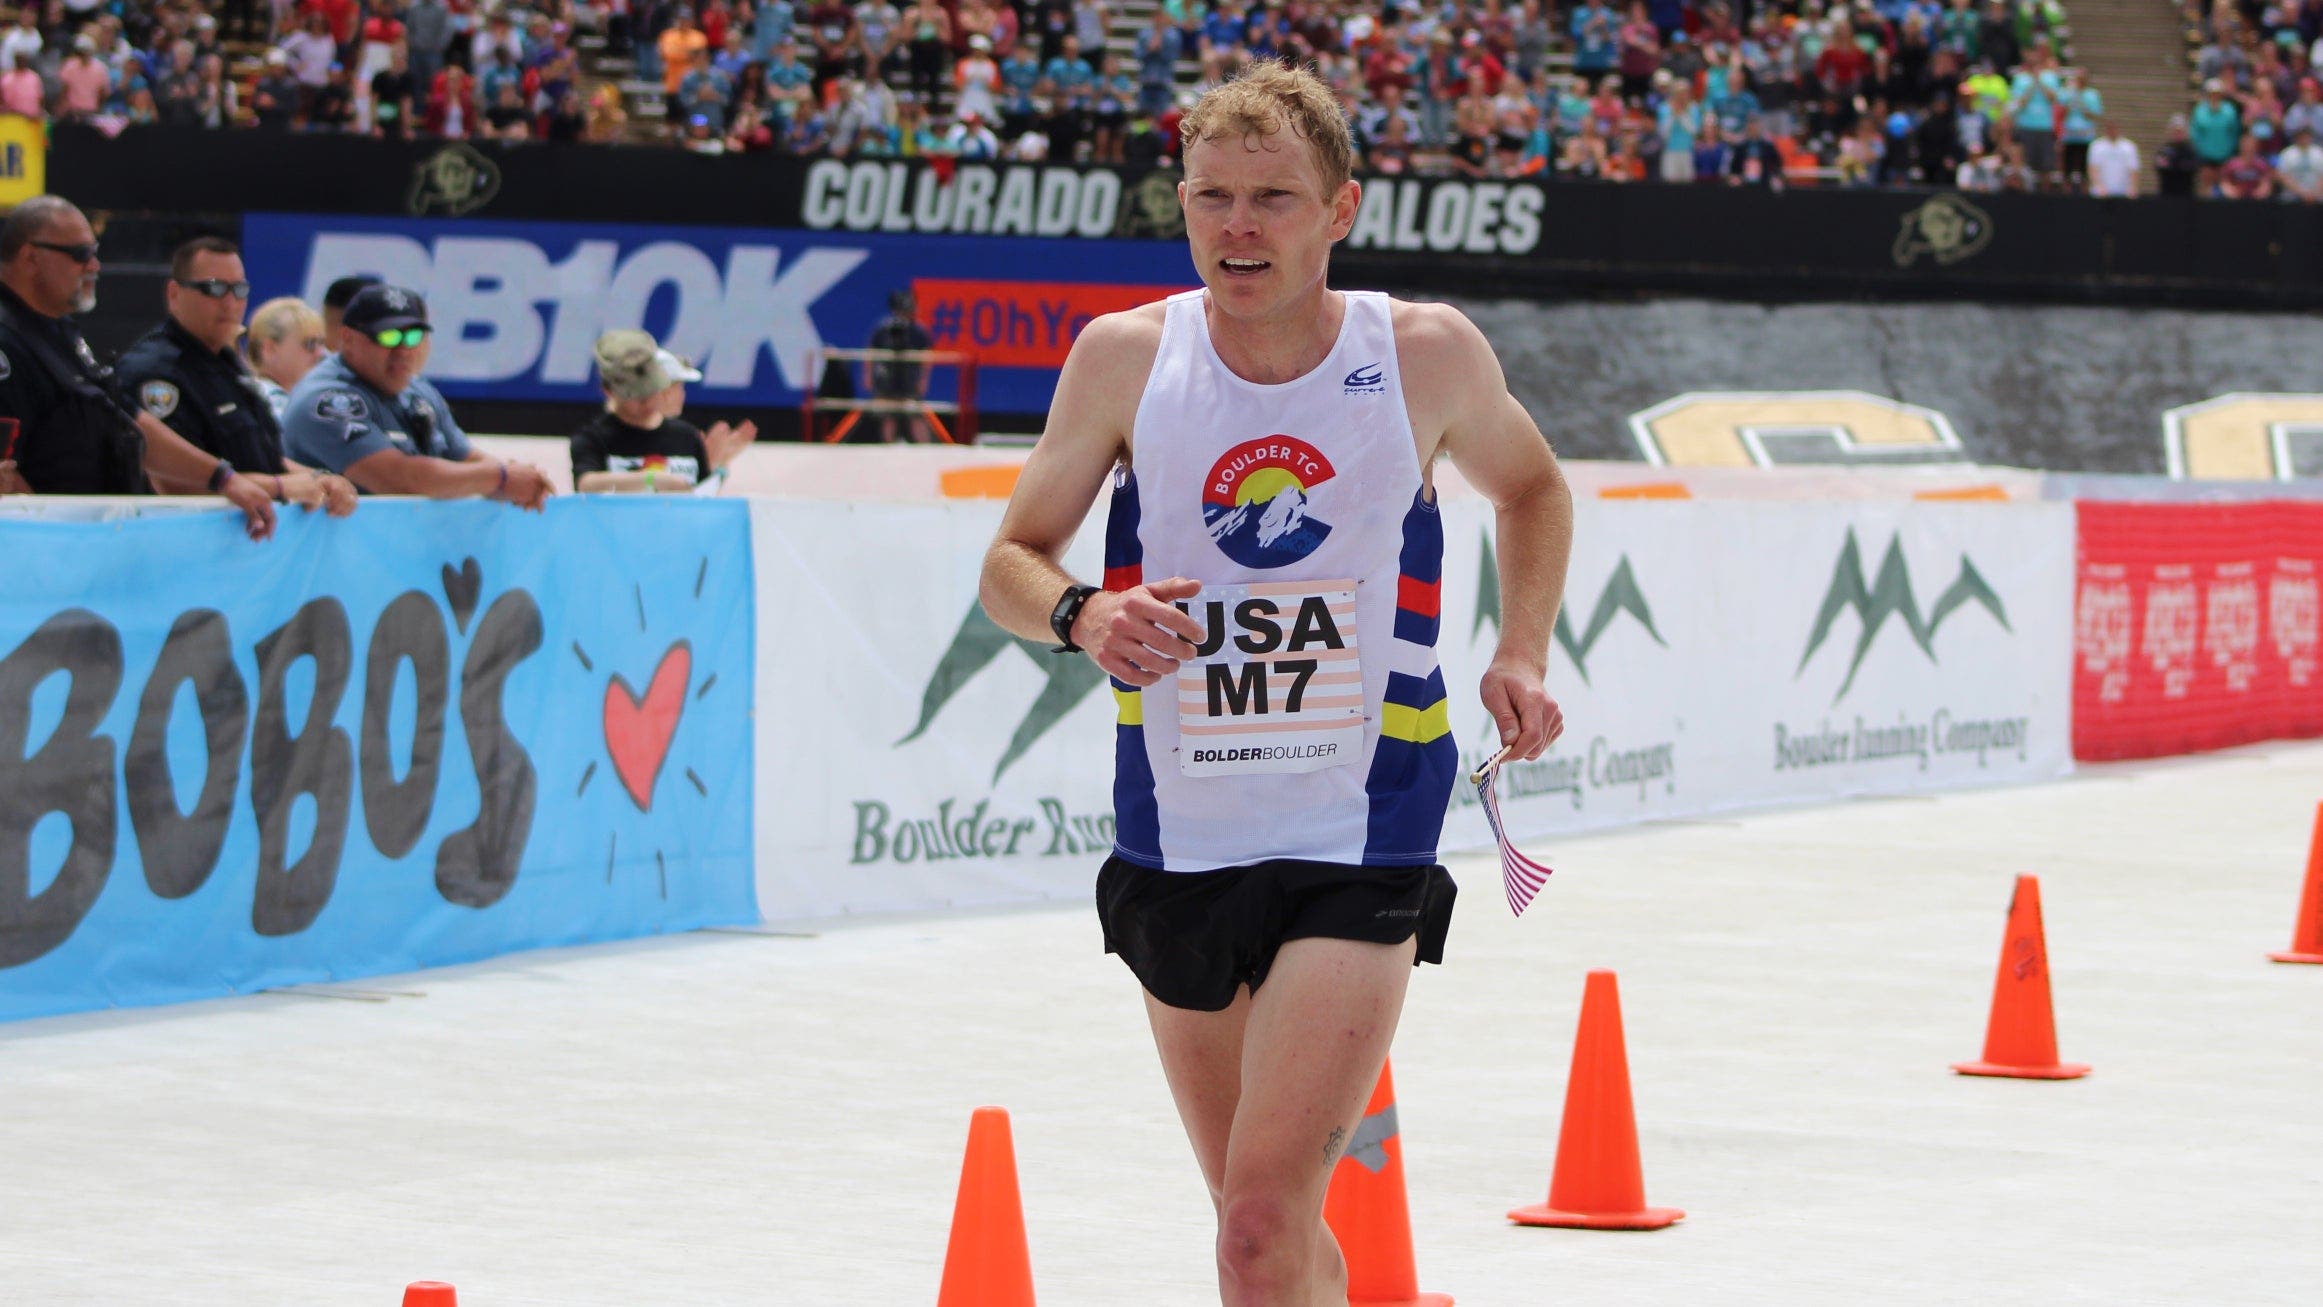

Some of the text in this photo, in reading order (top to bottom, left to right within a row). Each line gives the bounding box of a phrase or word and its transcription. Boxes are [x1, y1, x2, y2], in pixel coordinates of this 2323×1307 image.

[803, 158, 1546, 256] COLORADO ALOES
[1214, 445, 1319, 494] BOULDER TC
[1175, 596, 1345, 657] USA
[1206, 659, 1318, 717] M7
[1193, 743, 1338, 763] BOLDERBOULDER
[851, 797, 1034, 864] Boulder
